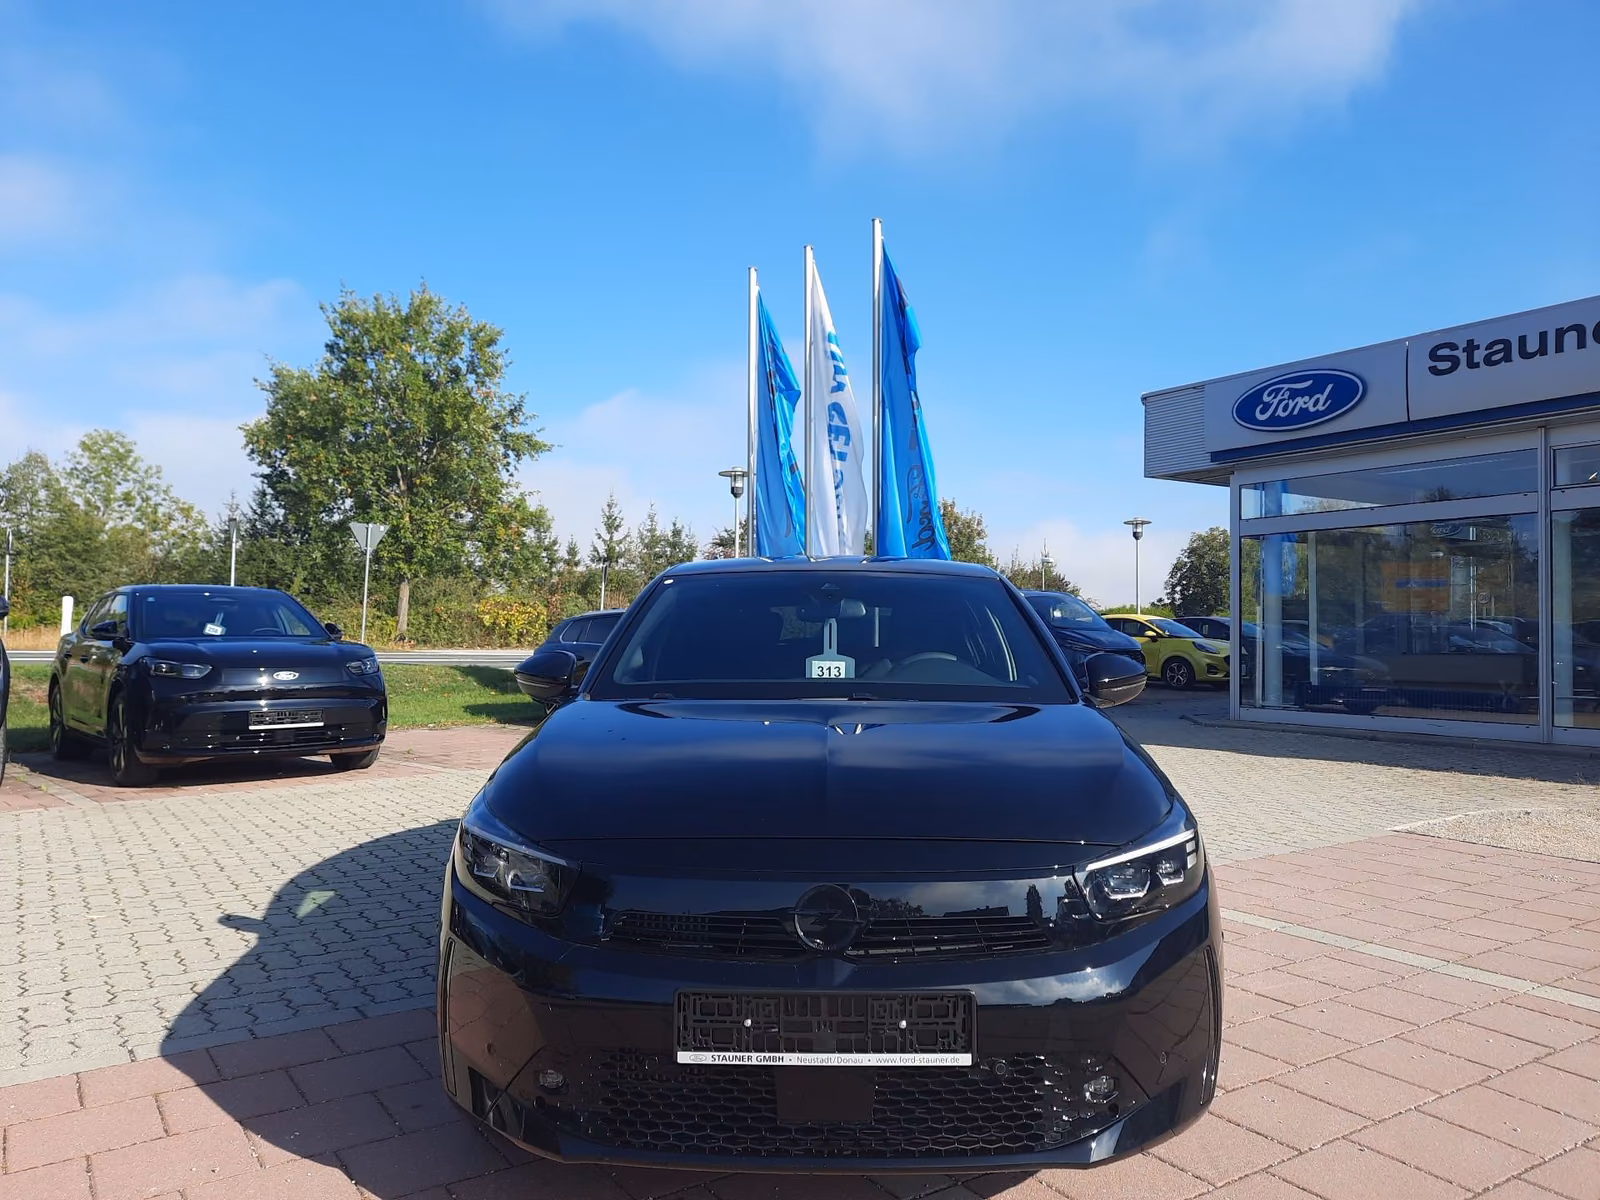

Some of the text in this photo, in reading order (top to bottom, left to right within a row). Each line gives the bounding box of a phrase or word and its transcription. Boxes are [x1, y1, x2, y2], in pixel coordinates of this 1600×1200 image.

[1427, 319, 1600, 377] Staun
[1255, 379, 1334, 421] Ford
[817, 665, 842, 678] 313
[710, 1054, 753, 1063] STAUNER
[755, 1055, 785, 1063] GMBH
[796, 1055, 864, 1064] Neustadt/Donau
[875, 1055, 960, 1064] www.ford-stauner.de
